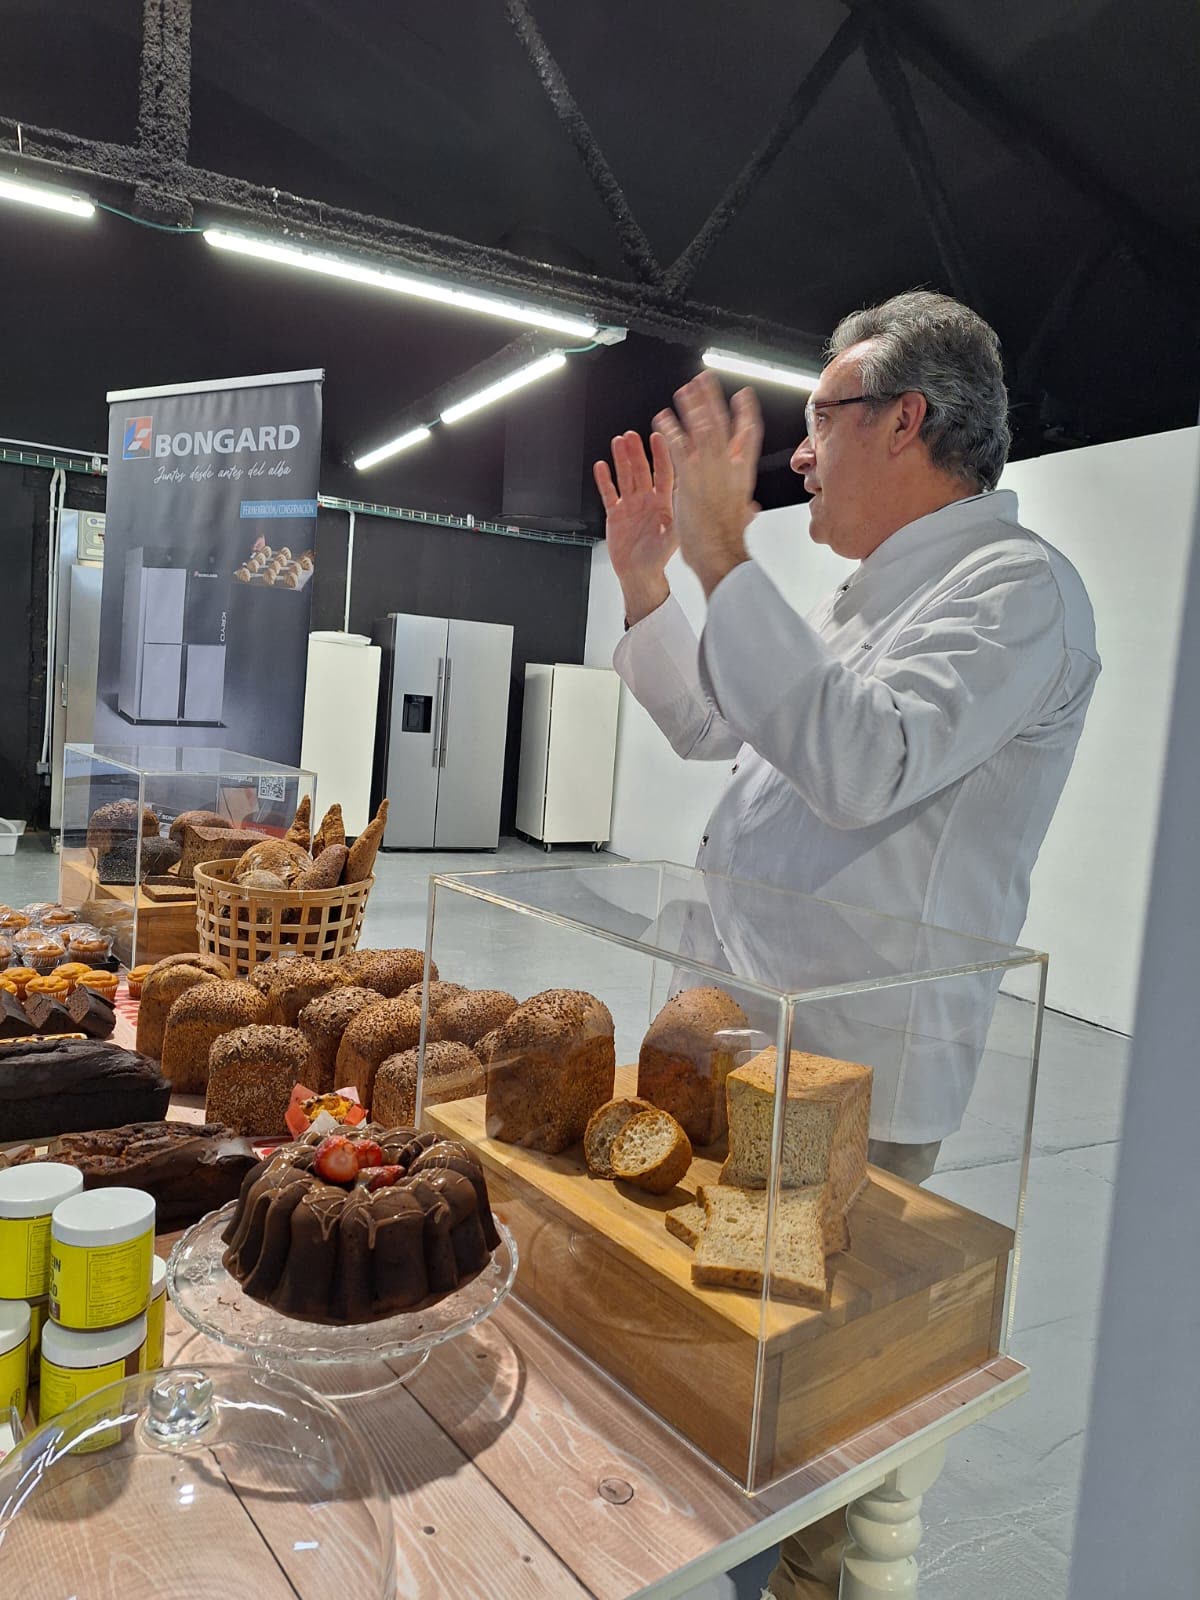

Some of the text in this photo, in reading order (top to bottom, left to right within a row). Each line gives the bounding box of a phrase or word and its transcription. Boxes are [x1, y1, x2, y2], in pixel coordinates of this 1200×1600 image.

[155, 424, 301, 458] BONGARD
[153, 460, 292, 484] Juntos desde antes del alba
